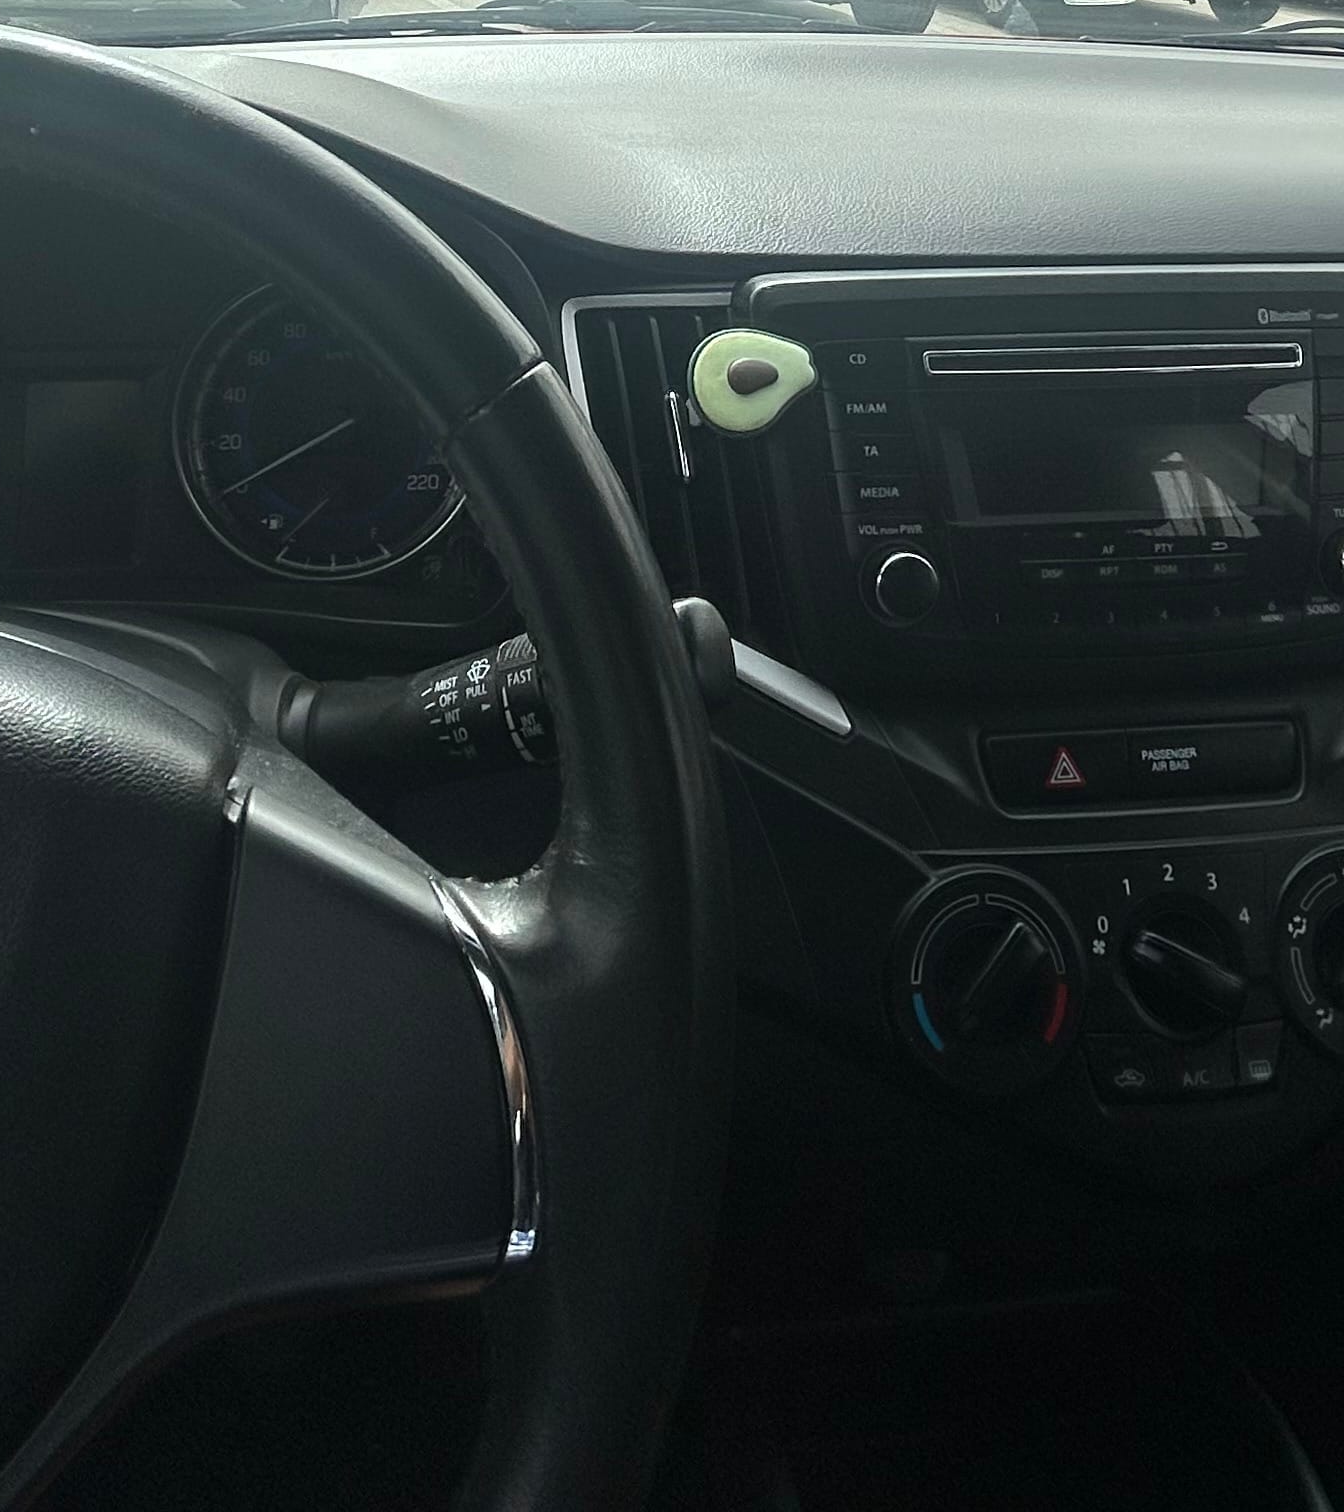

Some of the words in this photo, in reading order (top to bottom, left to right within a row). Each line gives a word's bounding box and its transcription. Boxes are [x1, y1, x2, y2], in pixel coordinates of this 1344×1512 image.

[284, 322, 306, 339] 80
[247, 350, 271, 366] 60
[849, 352, 867, 365] CD
[223, 386, 247, 404] 40
[846, 401, 888, 415] FM/AM
[218, 433, 242, 450] 20
[863, 445, 879, 457] TA
[407, 473, 440, 491] 220
[859, 486, 900, 499] MEDIA
[858, 524, 879, 536] VOL
[899, 523, 924, 535] PWR
[1101, 544, 1116, 555] AF
[1153, 542, 1174, 554] PTY
[1099, 566, 1120, 576] RPT
[1267, 601, 1277, 612] 6
[1306, 602, 1341, 616] SOUND
[1159, 609, 1169, 621] 4
[433, 675, 459, 693] MIST
[506, 668, 533, 687] FAST
[438, 690, 459, 708] OFF
[465, 683, 488, 700] PULL
[444, 708, 461, 725] INT
[519, 711, 536, 726] INT
[452, 726, 469, 744] LO
[520, 723, 544, 738] TIME
[1140, 746, 1198, 761] PASSENGER
[1151, 760, 1168, 772] AIR
[1168, 759, 1190, 771] BAG
[1161, 862, 1175, 882] 2
[1121, 877, 1132, 896] 1
[1205, 872, 1219, 891] 3
[1238, 906, 1251, 925] 4
[1096, 914, 1110, 935] 0
[1182, 1069, 1210, 1088] A/C
